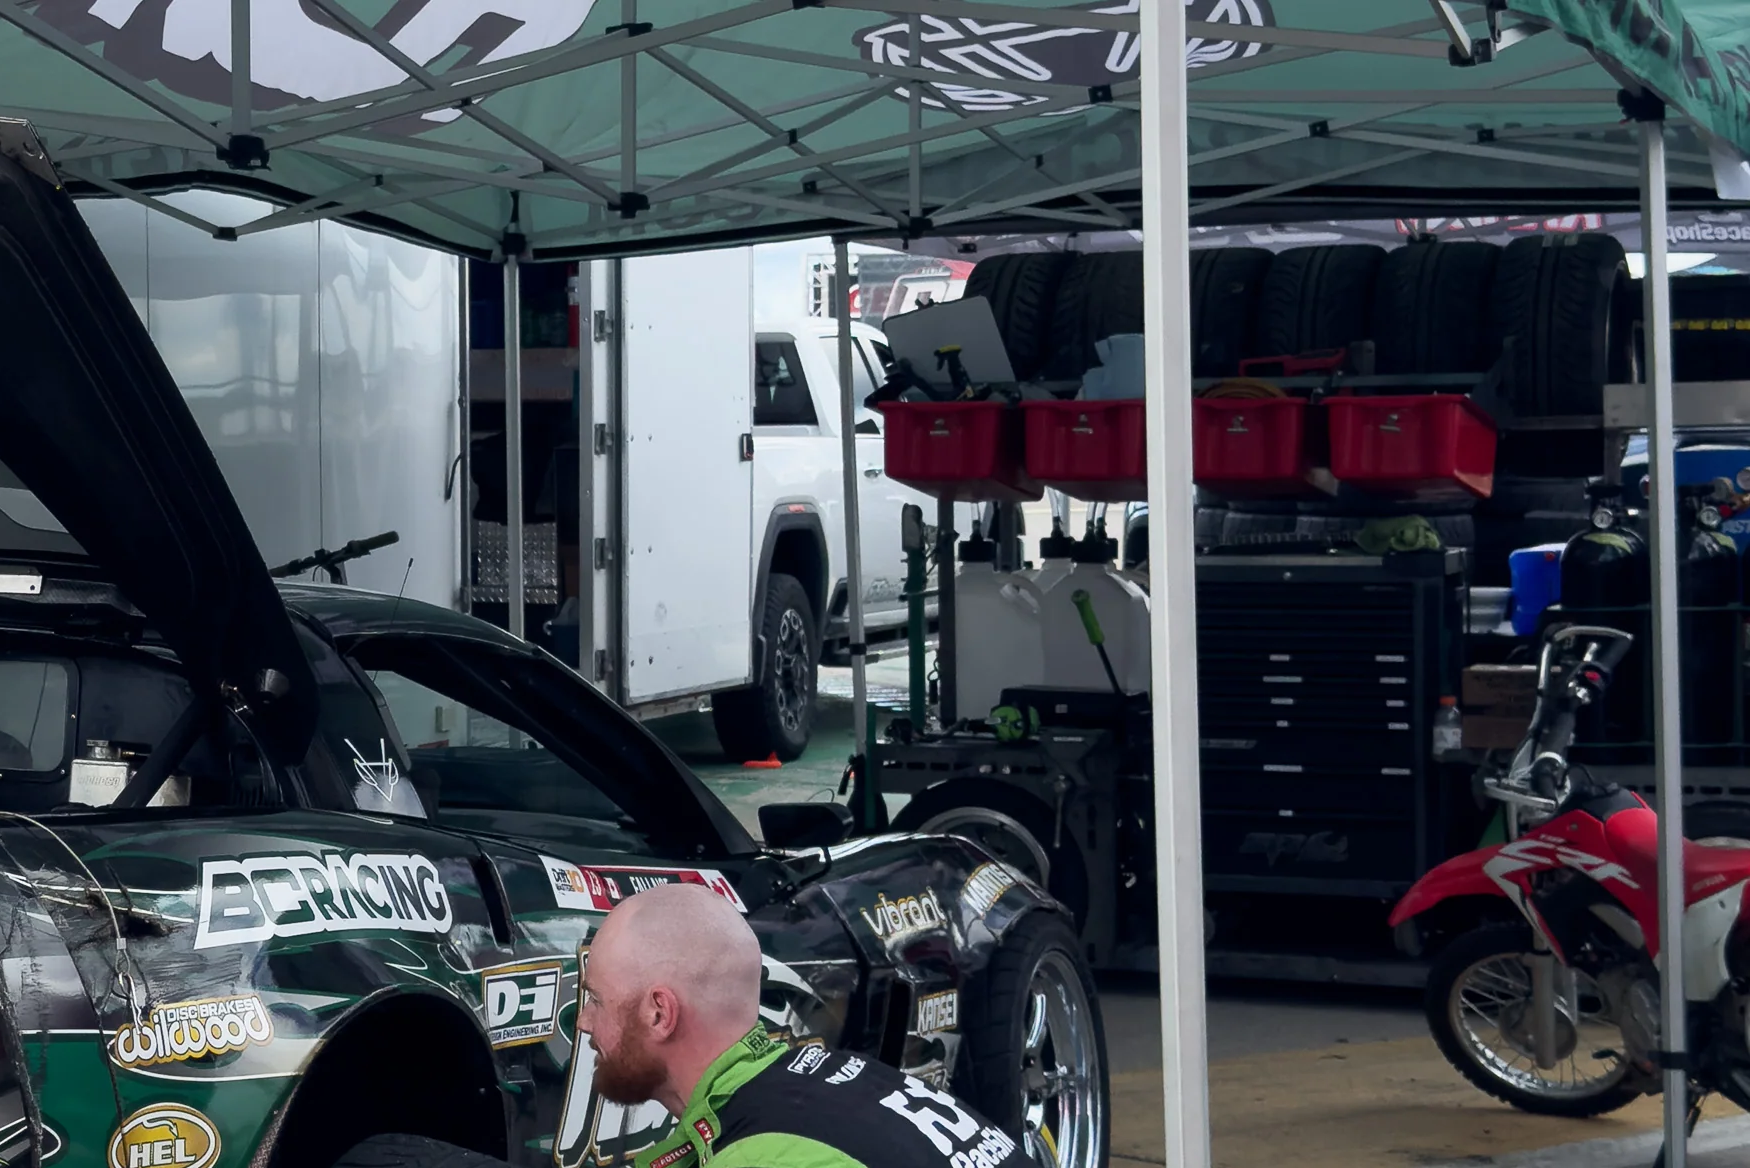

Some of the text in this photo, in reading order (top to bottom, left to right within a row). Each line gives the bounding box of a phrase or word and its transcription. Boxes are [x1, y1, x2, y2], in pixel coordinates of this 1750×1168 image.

[117, 997, 270, 1063] wilwood
[167, 999, 255, 1024] DISC BRAKES
